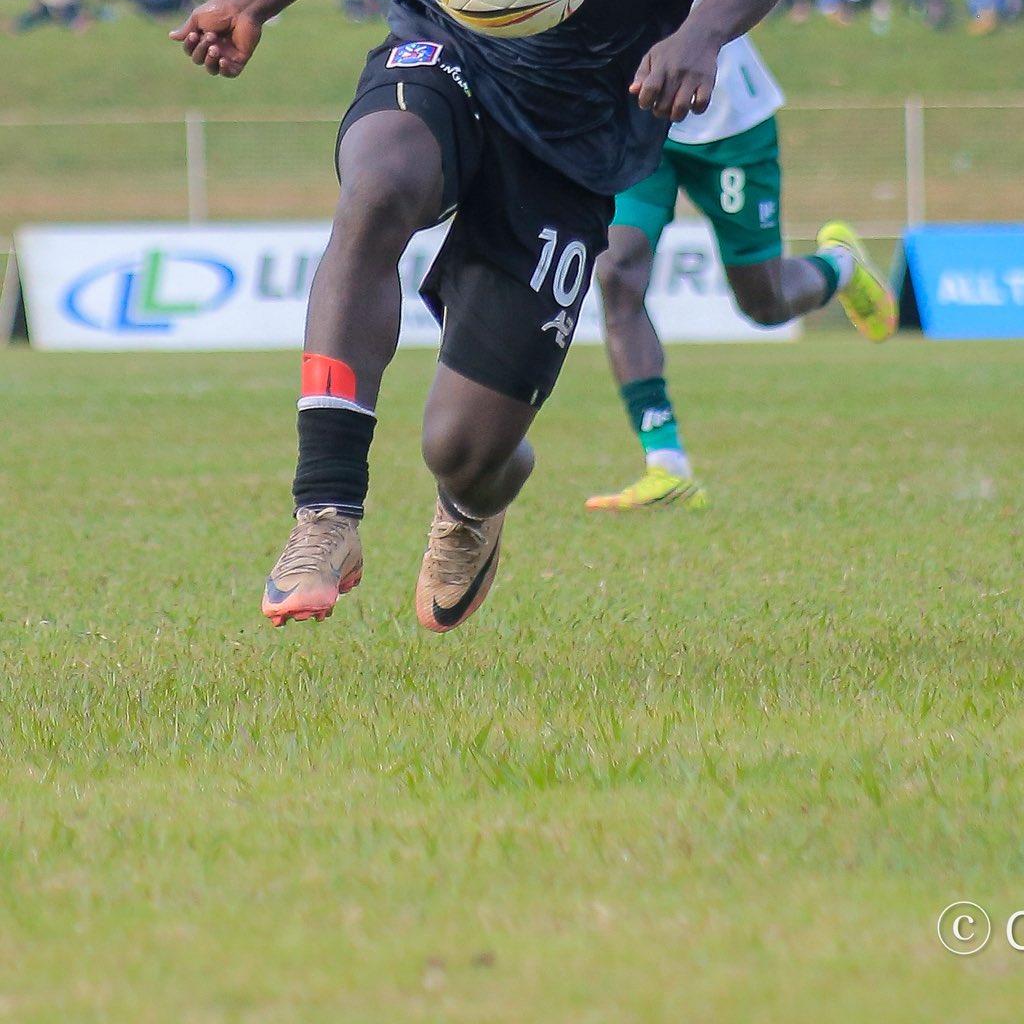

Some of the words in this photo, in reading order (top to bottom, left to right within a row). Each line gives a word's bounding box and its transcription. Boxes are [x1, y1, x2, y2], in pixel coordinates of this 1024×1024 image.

[720, 167, 745, 213] 8
[529, 228, 587, 307] 10
[938, 270, 1003, 306] ALL
